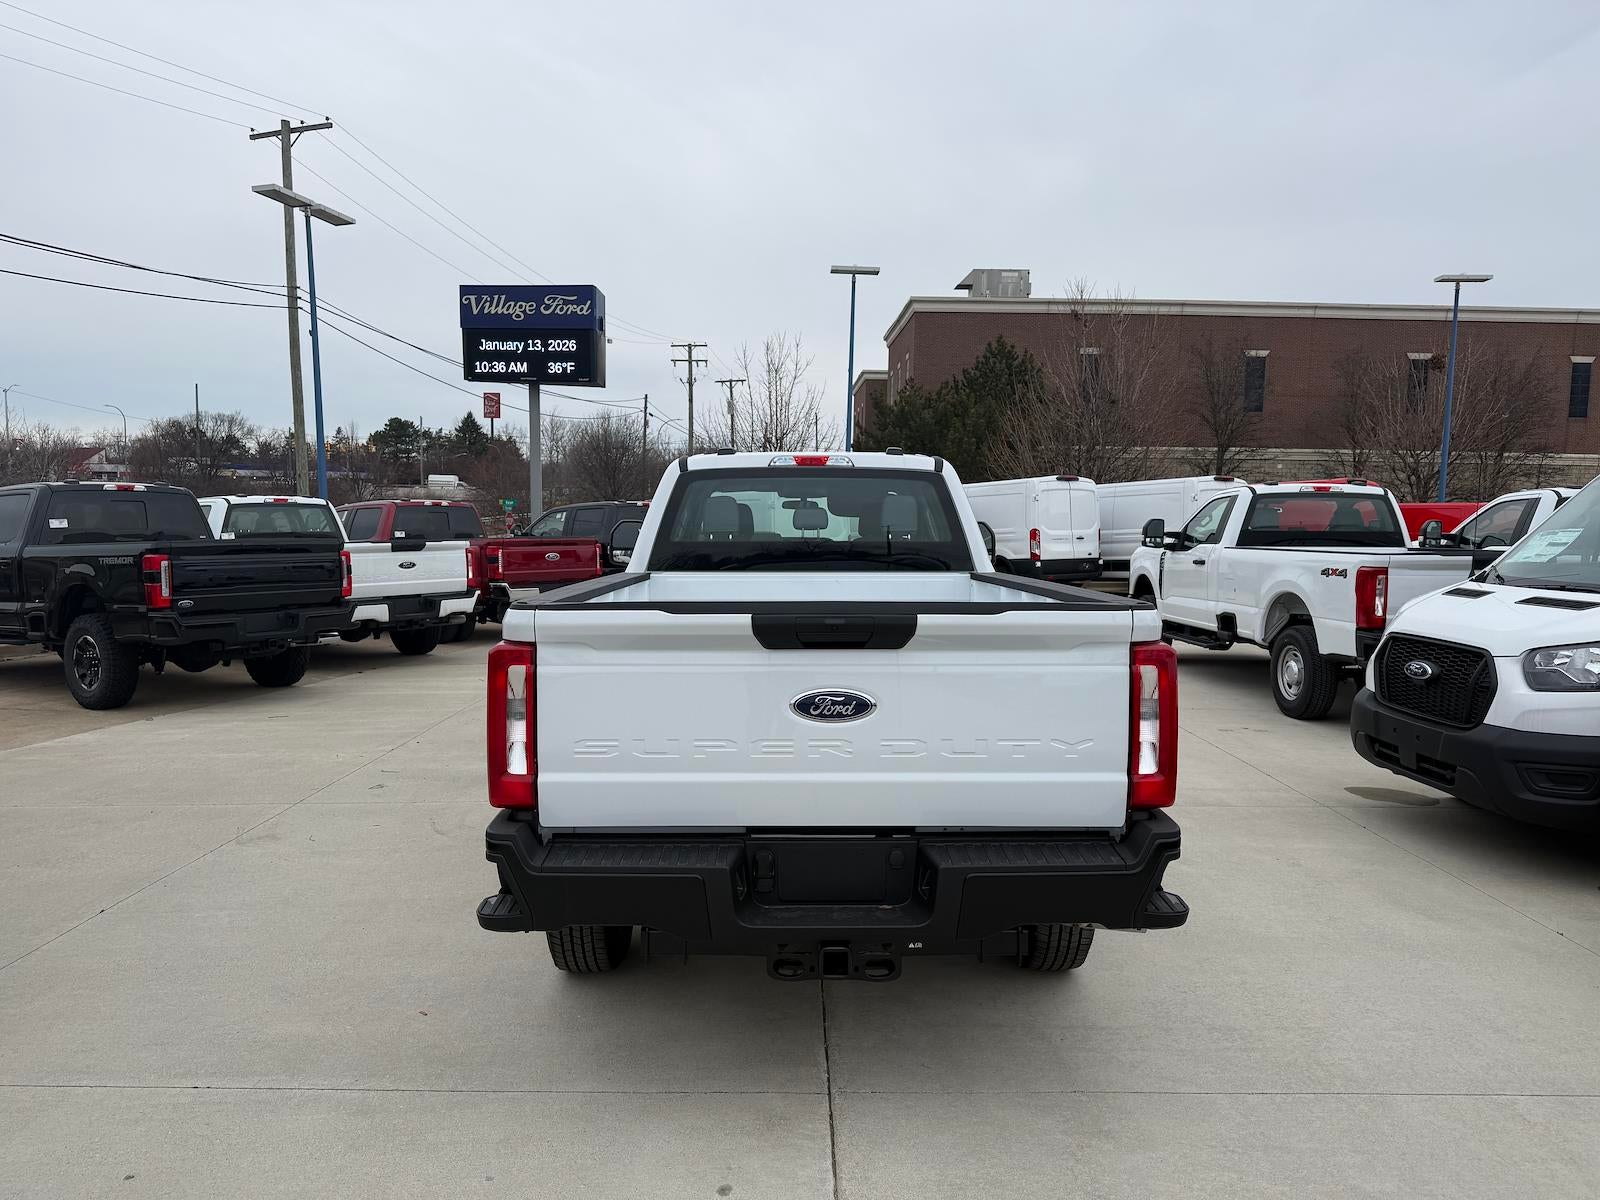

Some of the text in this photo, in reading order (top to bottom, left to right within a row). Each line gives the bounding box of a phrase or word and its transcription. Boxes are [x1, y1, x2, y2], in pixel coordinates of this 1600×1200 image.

[462, 294, 591, 320] Village Ford
[479, 339, 577, 353] January 13, 2026
[474, 361, 528, 373] 10:36 AM
[547, 362, 575, 374] 36°F
[98, 556, 134, 565] TREMOR
[810, 695, 857, 716] Ford
[573, 738, 1095, 759] SUPER DUTY
